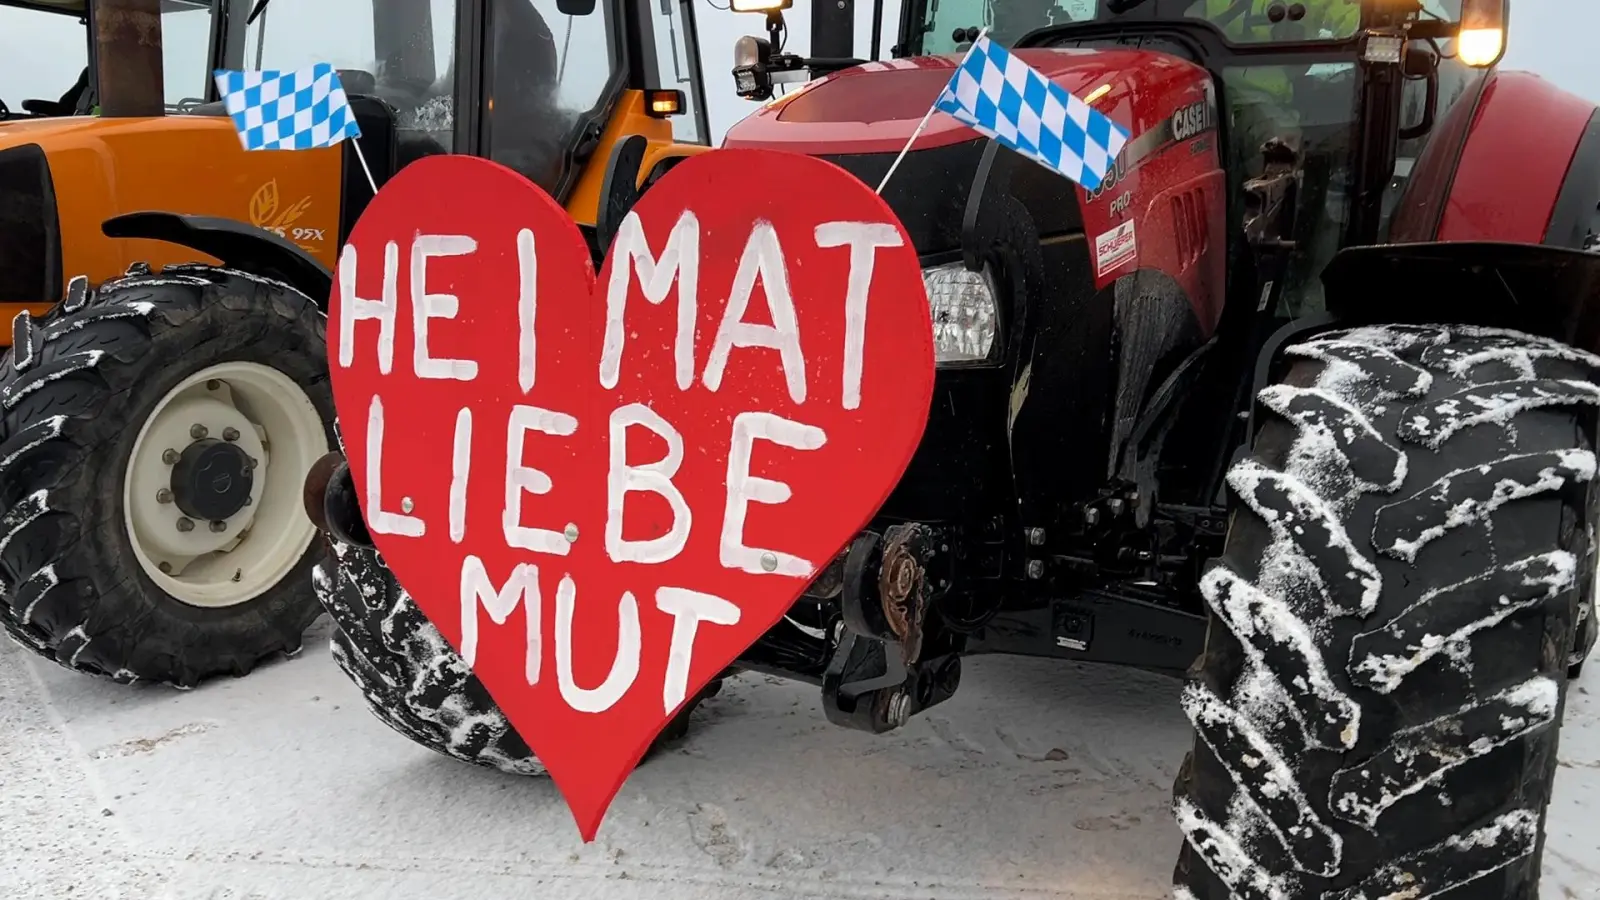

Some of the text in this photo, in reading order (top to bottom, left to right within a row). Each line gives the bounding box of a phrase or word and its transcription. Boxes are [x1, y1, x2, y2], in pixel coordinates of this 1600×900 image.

[1173, 102, 1204, 141] CASE
[291, 227, 326, 241] 95X
[1109, 190, 1131, 218] PRO
[338, 208, 905, 410] HEIMAT
[366, 394, 828, 579] LIEBE
[460, 555, 741, 716] MUT
